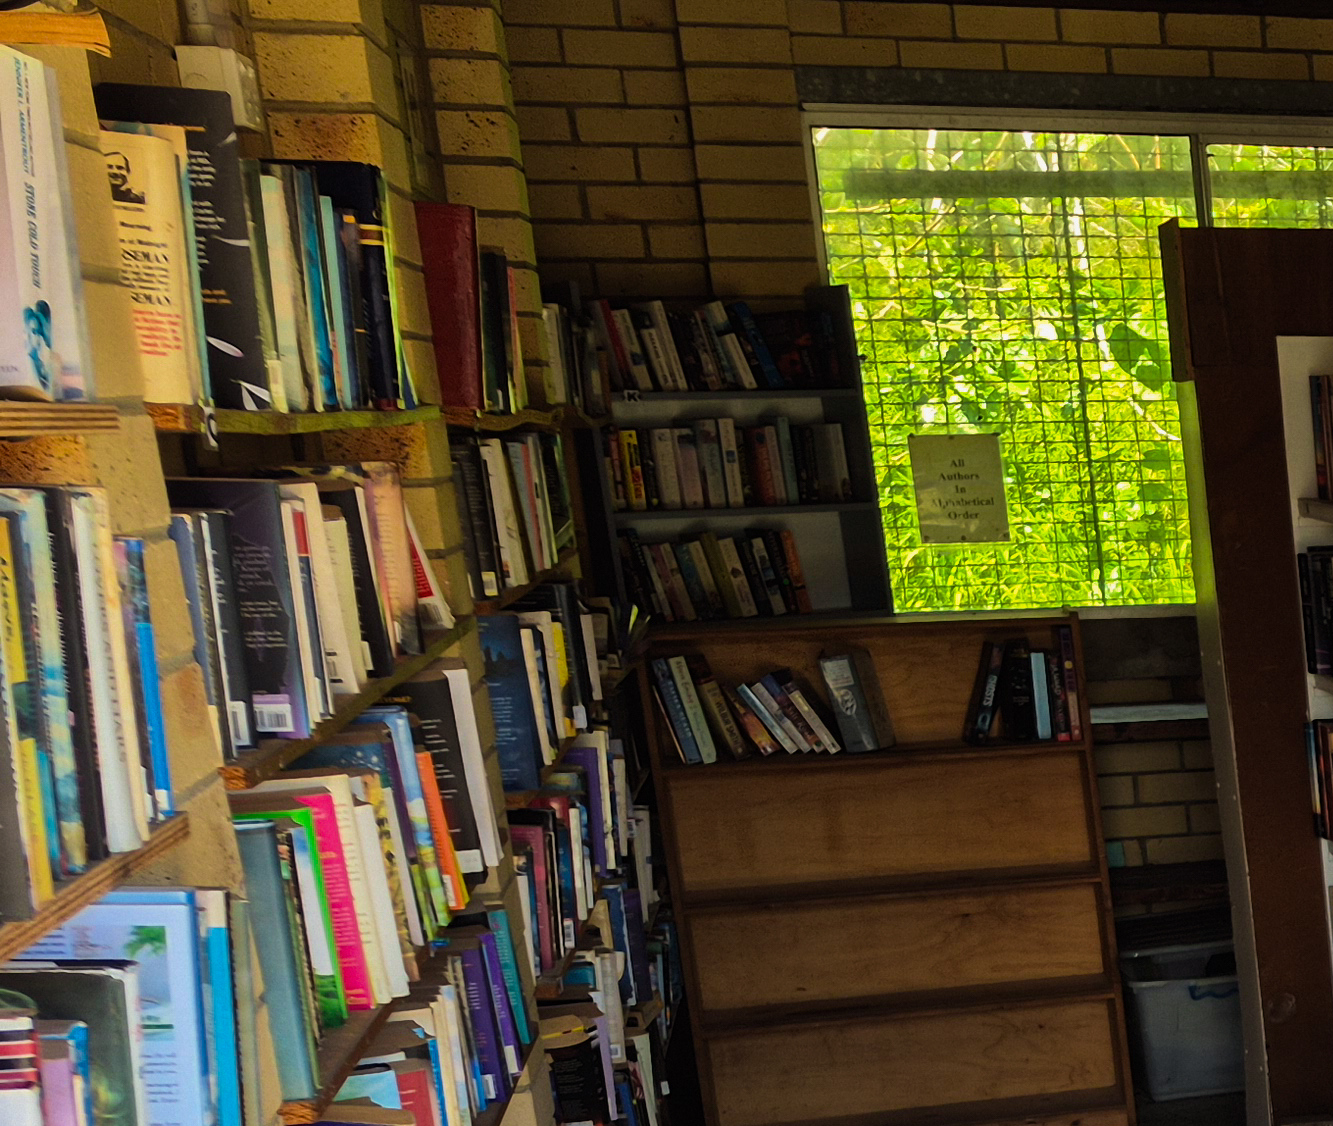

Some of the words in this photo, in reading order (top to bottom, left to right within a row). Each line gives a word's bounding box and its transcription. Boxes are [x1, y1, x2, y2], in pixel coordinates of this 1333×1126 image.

[950, 459, 965, 467] All
[940, 472, 979, 480] Authors
[955, 485, 966, 493] In
[948, 511, 980, 520] Order
